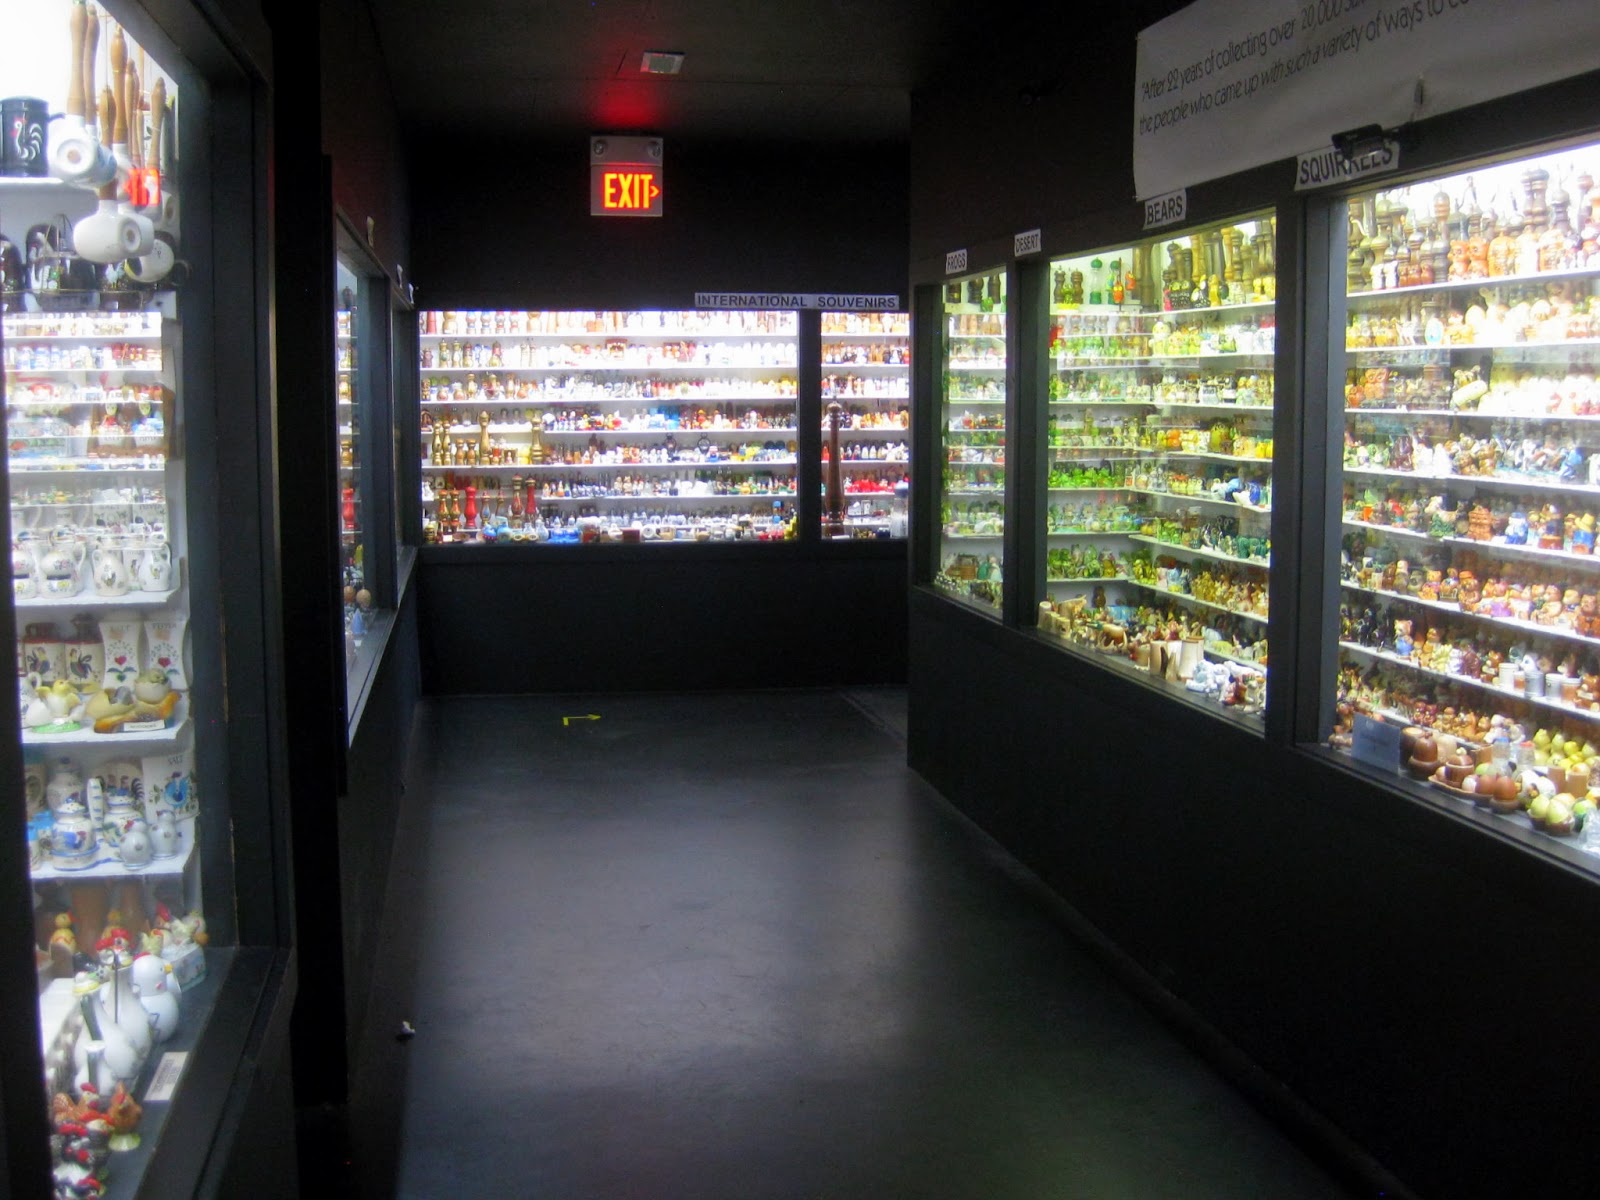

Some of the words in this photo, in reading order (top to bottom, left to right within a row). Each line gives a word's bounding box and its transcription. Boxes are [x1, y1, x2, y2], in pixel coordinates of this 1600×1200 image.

[1139, 112, 1153, 136] the
[1153, 100, 1189, 134] people
[1190, 91, 1213, 116] who
[1215, 80, 1242, 106] came
[1244, 74, 1259, 99] up
[1261, 58, 1285, 87] with
[1285, 44, 1311, 77] such
[1312, 44, 1320, 65] a
[1322, 25, 1364, 58] variety
[1366, 10, 1382, 41] of
[1383, 1, 1423, 33] ways
[1180, 62, 1203, 90] years
[1205, 50, 1216, 75] of
[1216, 32, 1267, 70] collecting
[1270, 18, 1297, 47] over
[603, 172, 654, 209] EXIT
[1145, 195, 1184, 226] BEARS
[1015, 233, 1039, 254] DESERT
[947, 252, 966, 271] FROGS
[697, 294, 808, 308] INTERNATIONAL
[817, 295, 896, 309] SOUVENIRS
